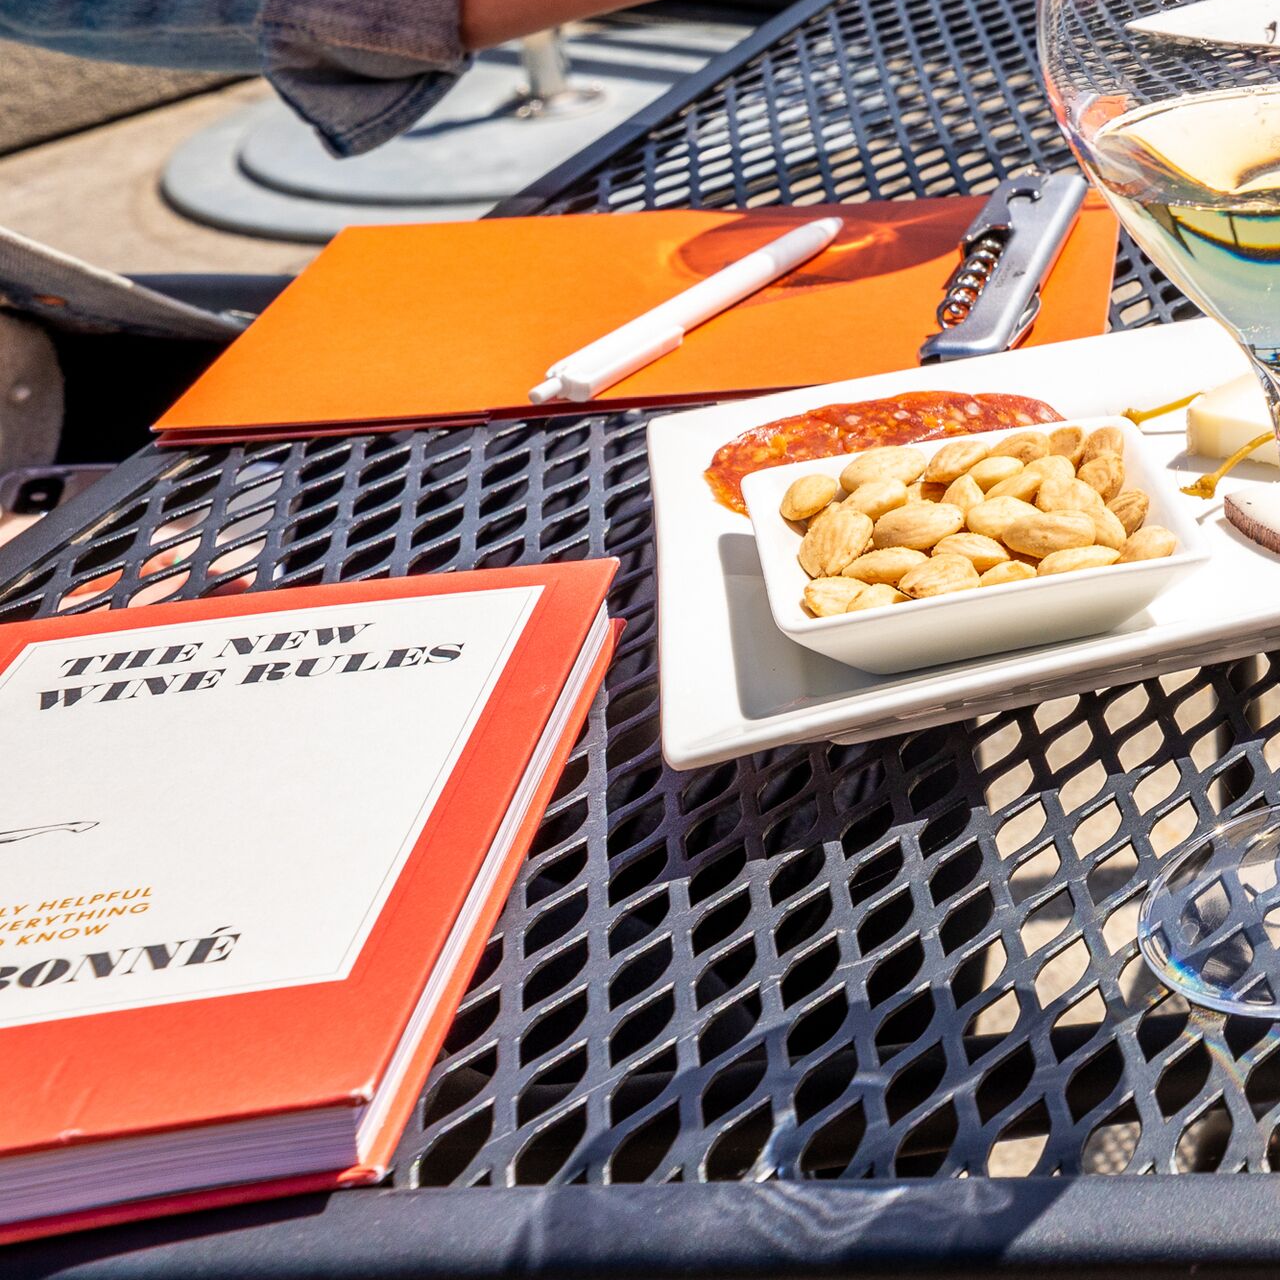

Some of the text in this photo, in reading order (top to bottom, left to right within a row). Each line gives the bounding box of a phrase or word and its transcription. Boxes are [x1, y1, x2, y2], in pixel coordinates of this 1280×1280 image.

[58, 622, 376, 679] THE NEW
[36, 642, 465, 711] WINE RULES
[37, 887, 153, 912] HELPFUL
[15, 923, 109, 946] KNOW
